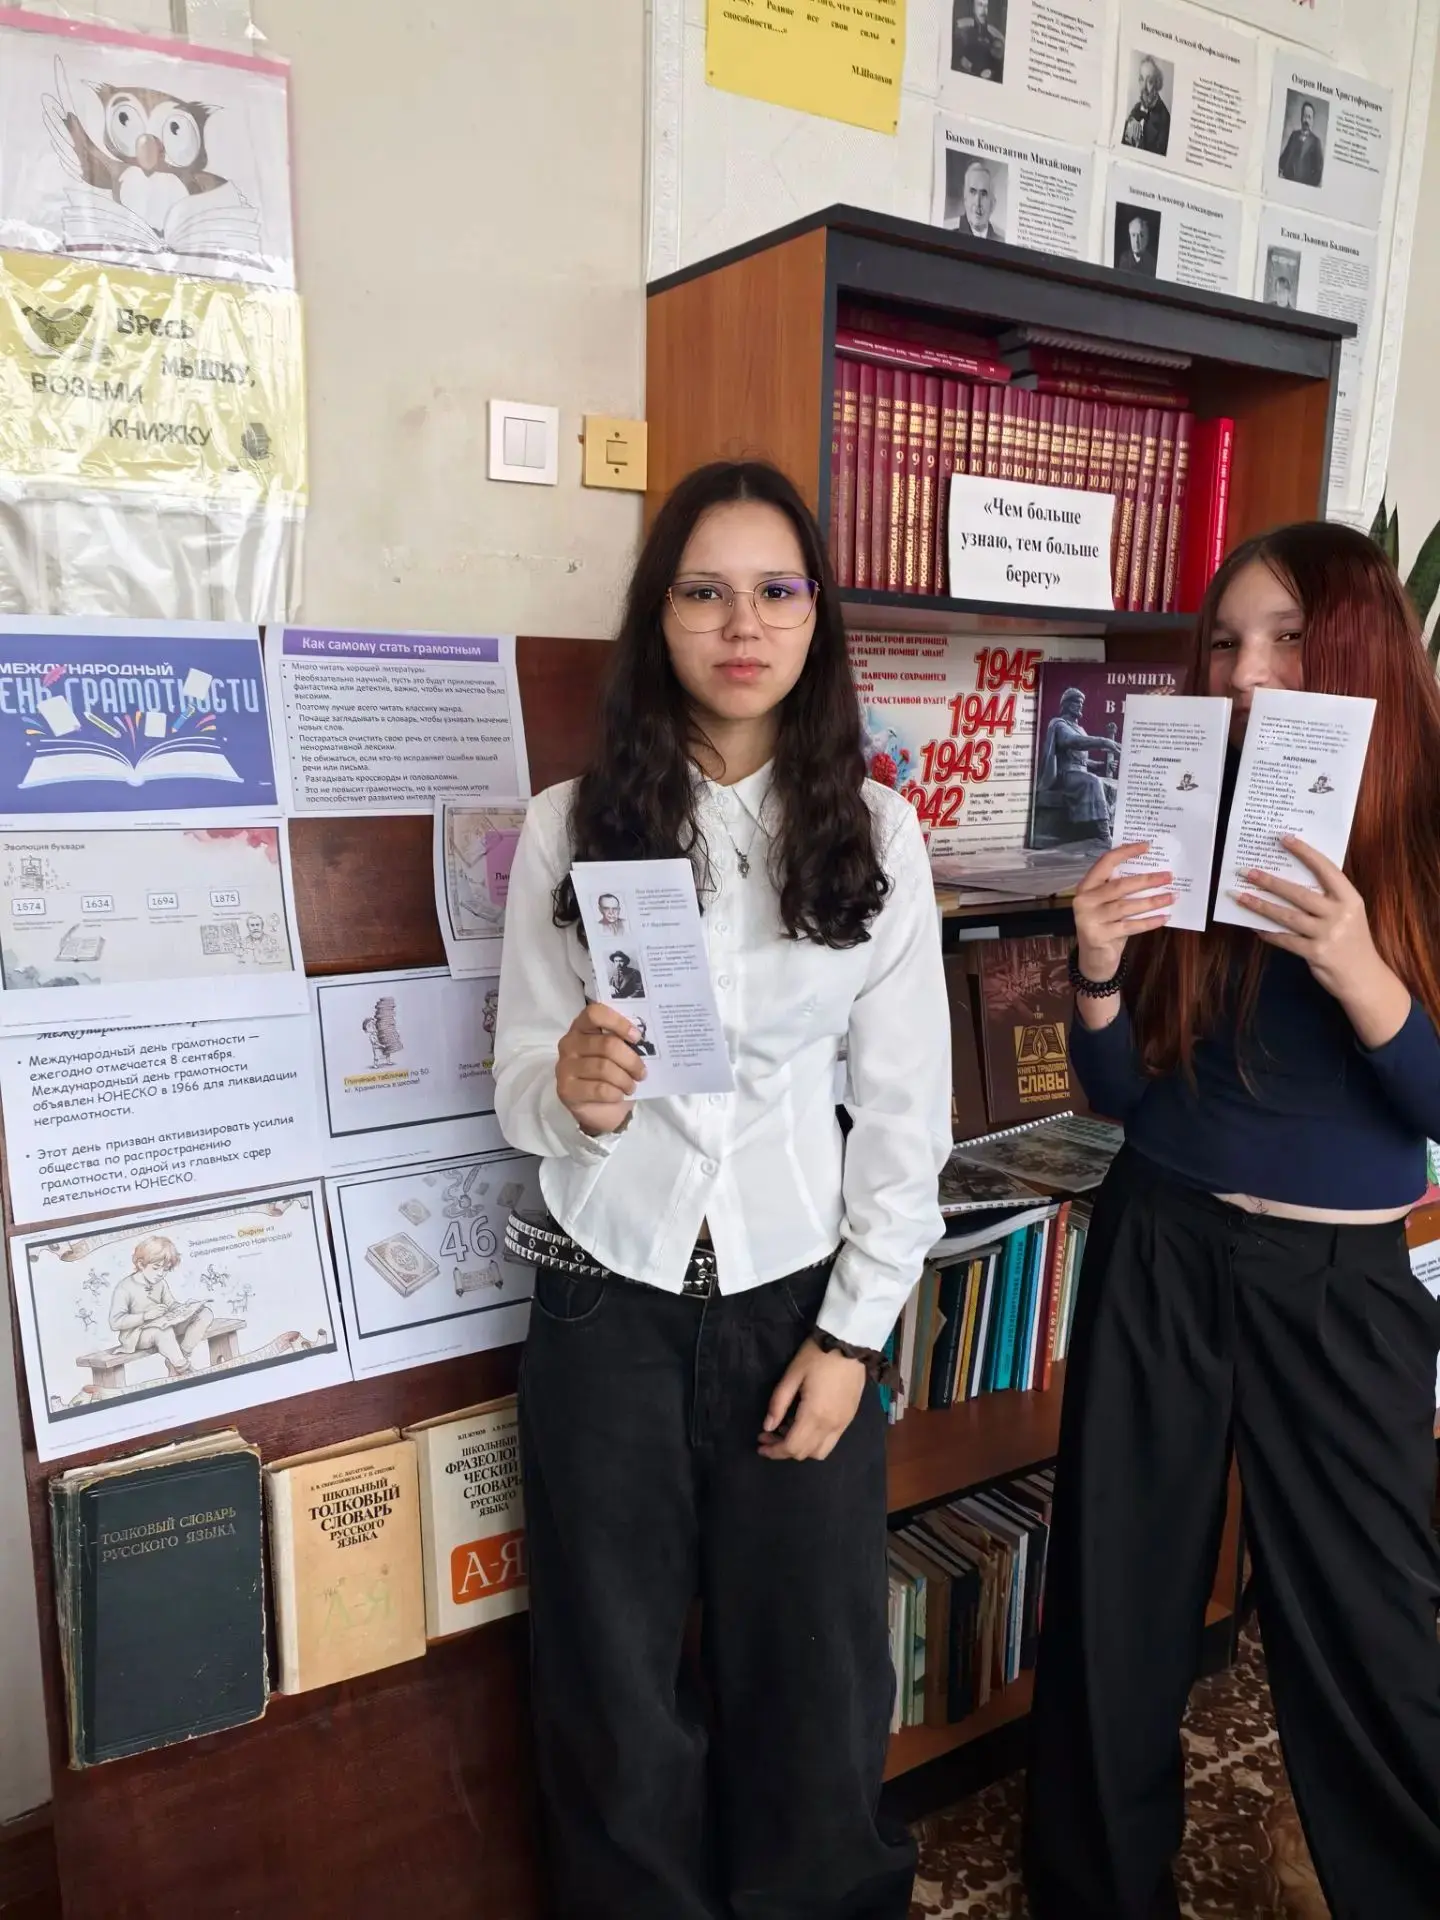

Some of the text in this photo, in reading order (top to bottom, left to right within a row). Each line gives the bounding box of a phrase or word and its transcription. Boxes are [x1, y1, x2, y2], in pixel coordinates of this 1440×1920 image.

[945, 129, 1082, 176] Быков Константин Михайлович
[896, 450, 904, 463] 9
[912, 452, 920, 466] 9
[927, 454, 935, 468] 9
[955, 459, 966, 473] 10
[971, 459, 982, 474] 10
[987, 460, 998, 475] 10
[1002, 462, 1012, 476] 10
[1013, 464, 1024, 477] 10
[1050, 470, 1060, 483] 10
[1089, 475, 1099, 487] 10
[1127, 477, 1136, 490] 10
[984, 497, 1081, 525] «Чем больше
[961, 532, 1099, 558] узнаю, тем больше
[1006, 564, 1061, 589] берегу»
[302, 637, 481, 656] Как самому стать грамотным
[973, 646, 1044, 693] 1945
[1107, 672, 1176, 686] ПОМНИТЬ
[948, 693, 1017, 738] 1944
[921, 738, 993, 786] 1943
[901, 785, 965, 829] 942
[29, 1044, 136, 1067] Международный
[140, 1043, 168, 1055] день
[171, 1034, 246, 1052] грамотности
[30, 1049, 236, 1082] ежегодно отмечается 8 сентября.
[32, 1063, 248, 1097] Международный день грамотности
[33, 1071, 297, 1112] объявлен ЮНЕСКО в 1966 для ликвидации
[1018, 1071, 1069, 1095] СЛАВЫ
[34, 1107, 135, 1127] неграмотности.
[37, 1116, 294, 1160] Этот день призван активизировать усилия
[38, 1138, 232, 1175] общества по распространению
[130, 1160, 169, 1176] одной
[172, 1160, 186, 1170] из
[190, 1153, 239, 1167] главных
[243, 1147, 272, 1162] сфер
[42, 1184, 131, 1207] деятельности
[440, 1215, 497, 1262] 46
[462, 1435, 517, 1457] ШКОЛЬНЫЙ
[464, 1461, 518, 1483] ЧЕСКИЙ
[322, 1477, 388, 1502] ШКОЛЬНЫЙ
[463, 1474, 523, 1499] СЛОВАРЬ
[308, 1484, 400, 1520] ТОЛКОВЫЙ
[470, 1490, 517, 1510] РУССКОГО
[479, 1503, 510, 1518] ЯЗЫКА
[102, 1507, 237, 1545] ТОЛКОВЫЙ СЛОВАРЬ
[321, 1503, 393, 1531] СЛОВАРЬ
[330, 1518, 384, 1541] РУССКОГО
[337, 1531, 378, 1549] ЯЗЫКА
[102, 1522, 237, 1563] РУССКОГО ЯЗЫКА
